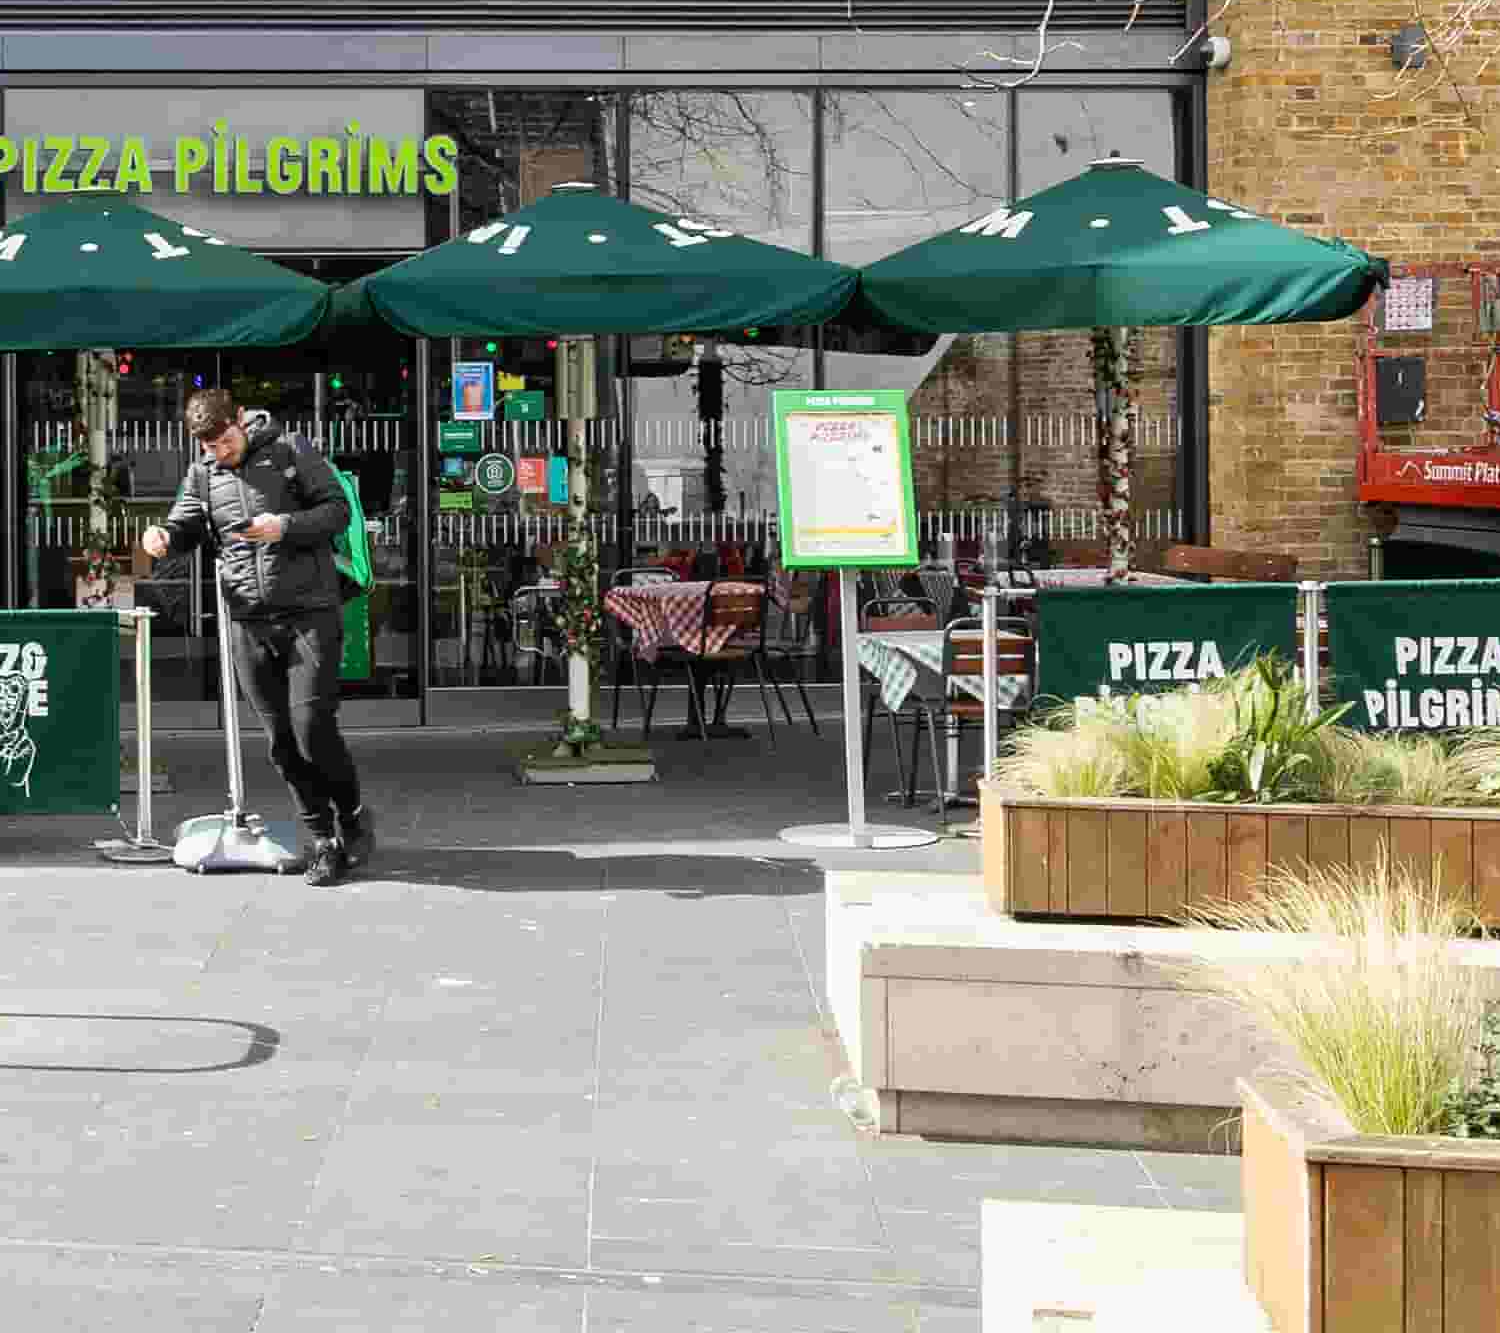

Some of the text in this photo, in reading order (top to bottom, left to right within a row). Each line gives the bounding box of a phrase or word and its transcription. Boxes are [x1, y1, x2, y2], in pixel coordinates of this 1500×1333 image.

[176, 119, 459, 196] PILGRIMS
[1423, 460, 1473, 484] Summit
[1108, 641, 1226, 680] PIZZA
